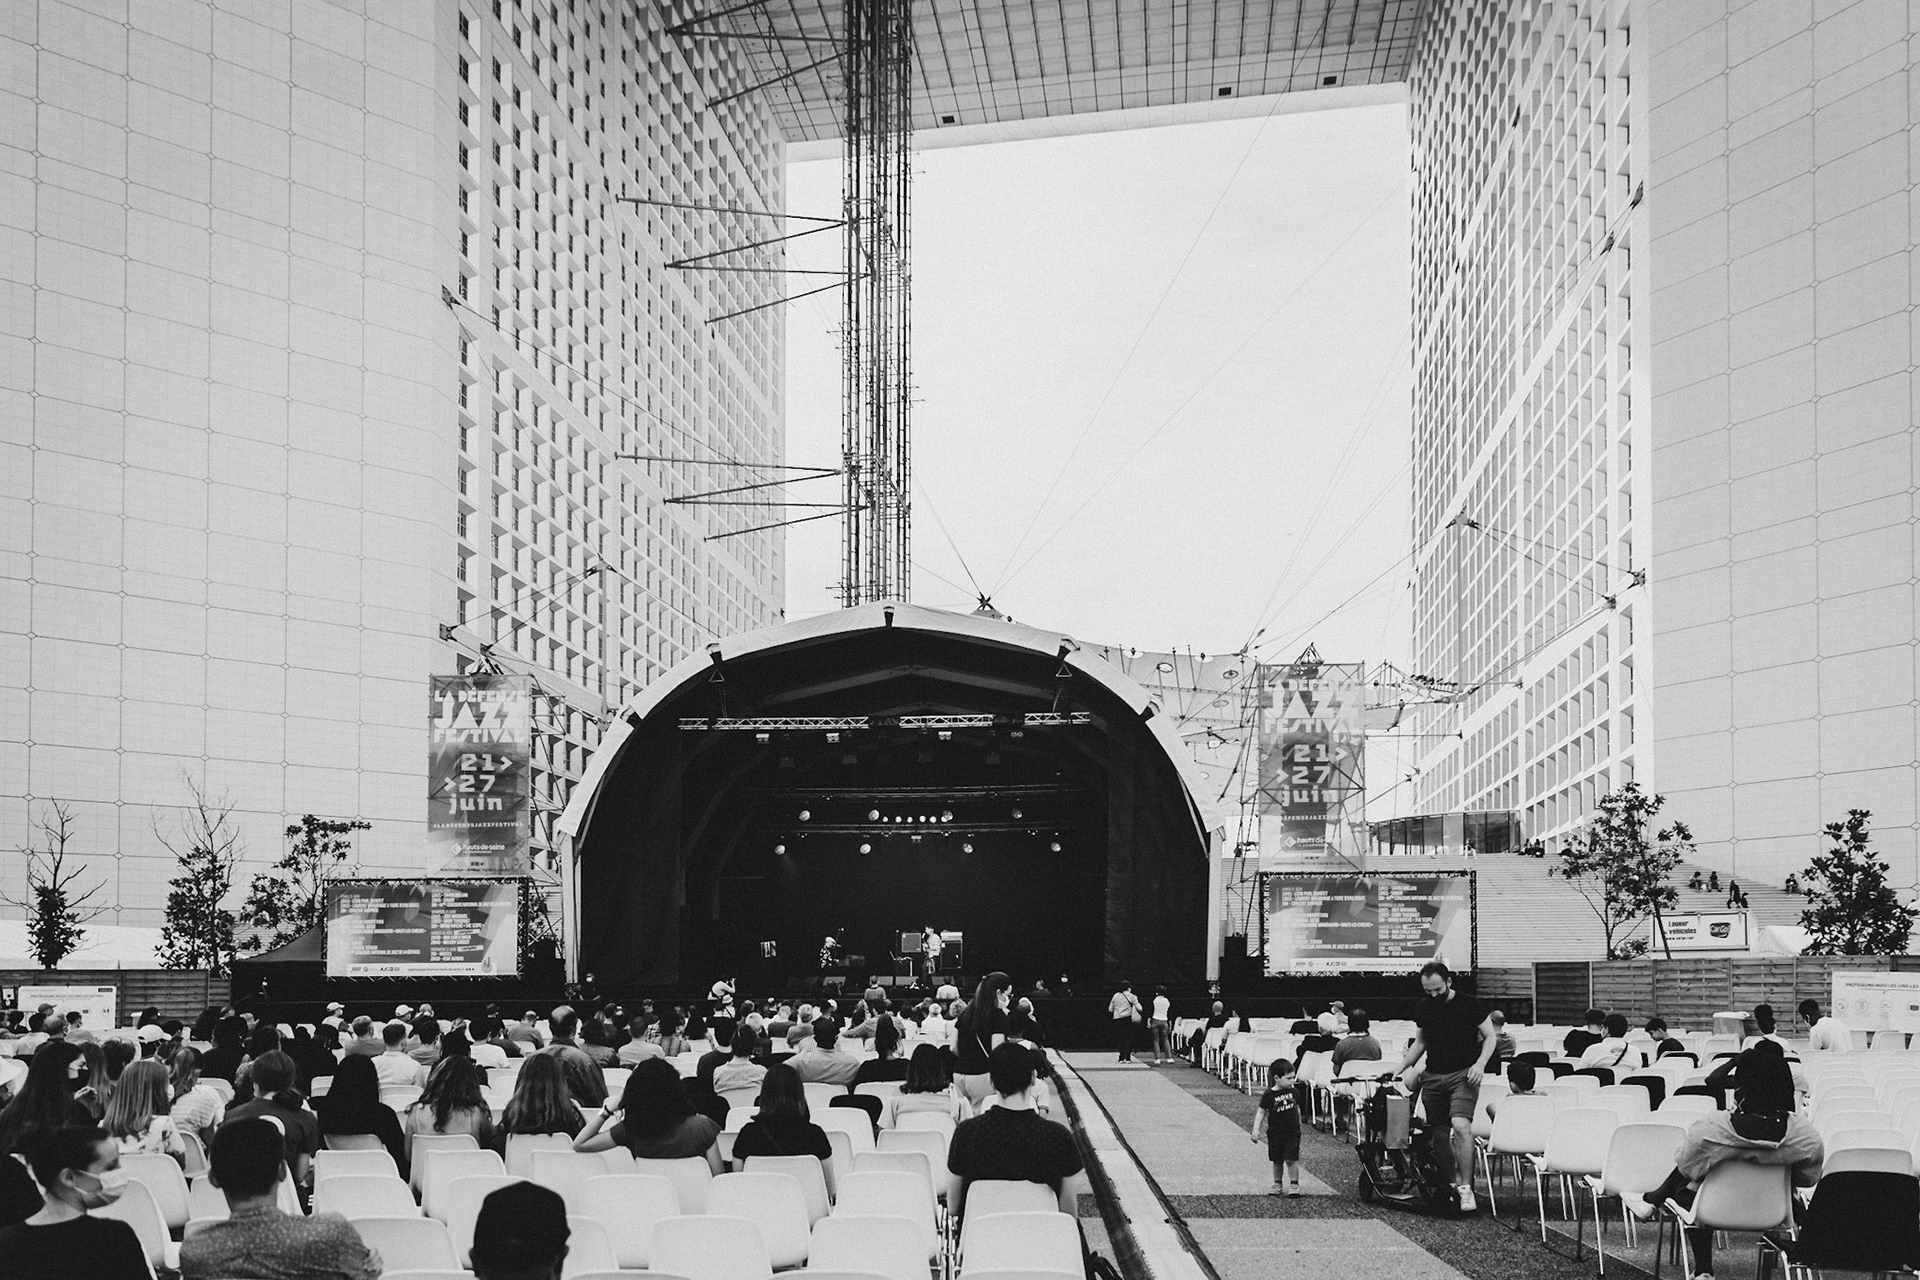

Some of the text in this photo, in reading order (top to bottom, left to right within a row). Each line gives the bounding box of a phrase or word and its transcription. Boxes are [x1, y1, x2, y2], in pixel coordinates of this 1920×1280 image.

[1264, 679, 1285, 691] LA
[435, 690, 455, 702] LA
[1264, 691, 1362, 718] JAZZ
[434, 701, 526, 728] JAZZ
[1264, 719, 1361, 734] FESTIVAL
[434, 729, 525, 743] FESTIVAL
[1281, 784, 1338, 806] juin
[449, 793, 502, 814] juin
[1275, 1093, 1293, 1102] MOVE
[1277, 1103, 1294, 1112] JUMP
